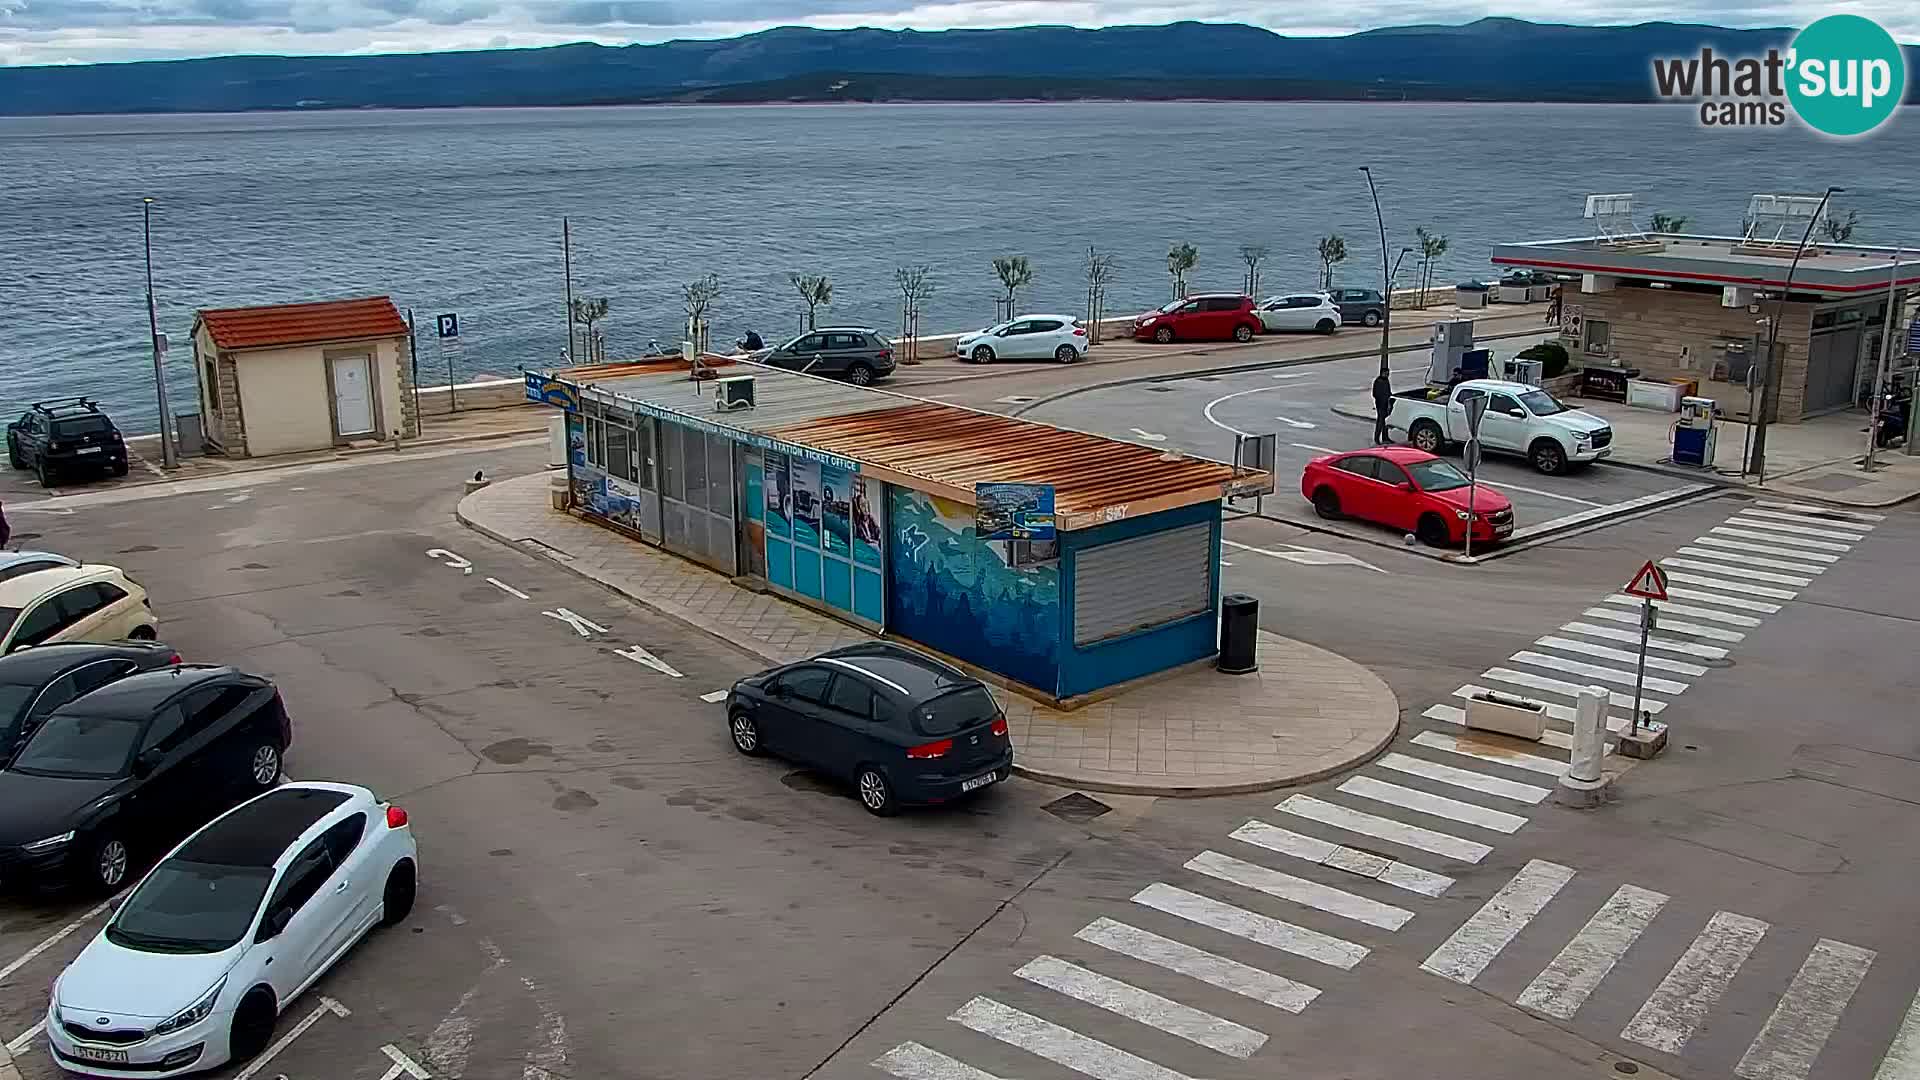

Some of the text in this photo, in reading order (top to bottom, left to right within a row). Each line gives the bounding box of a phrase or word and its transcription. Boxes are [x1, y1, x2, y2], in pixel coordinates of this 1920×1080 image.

[442, 317, 452, 334] P
[758, 439, 771, 449] BUS
[771, 442, 803, 458] STATION
[805, 450, 829, 464] TICKET
[831, 456, 857, 471] OFFICE
